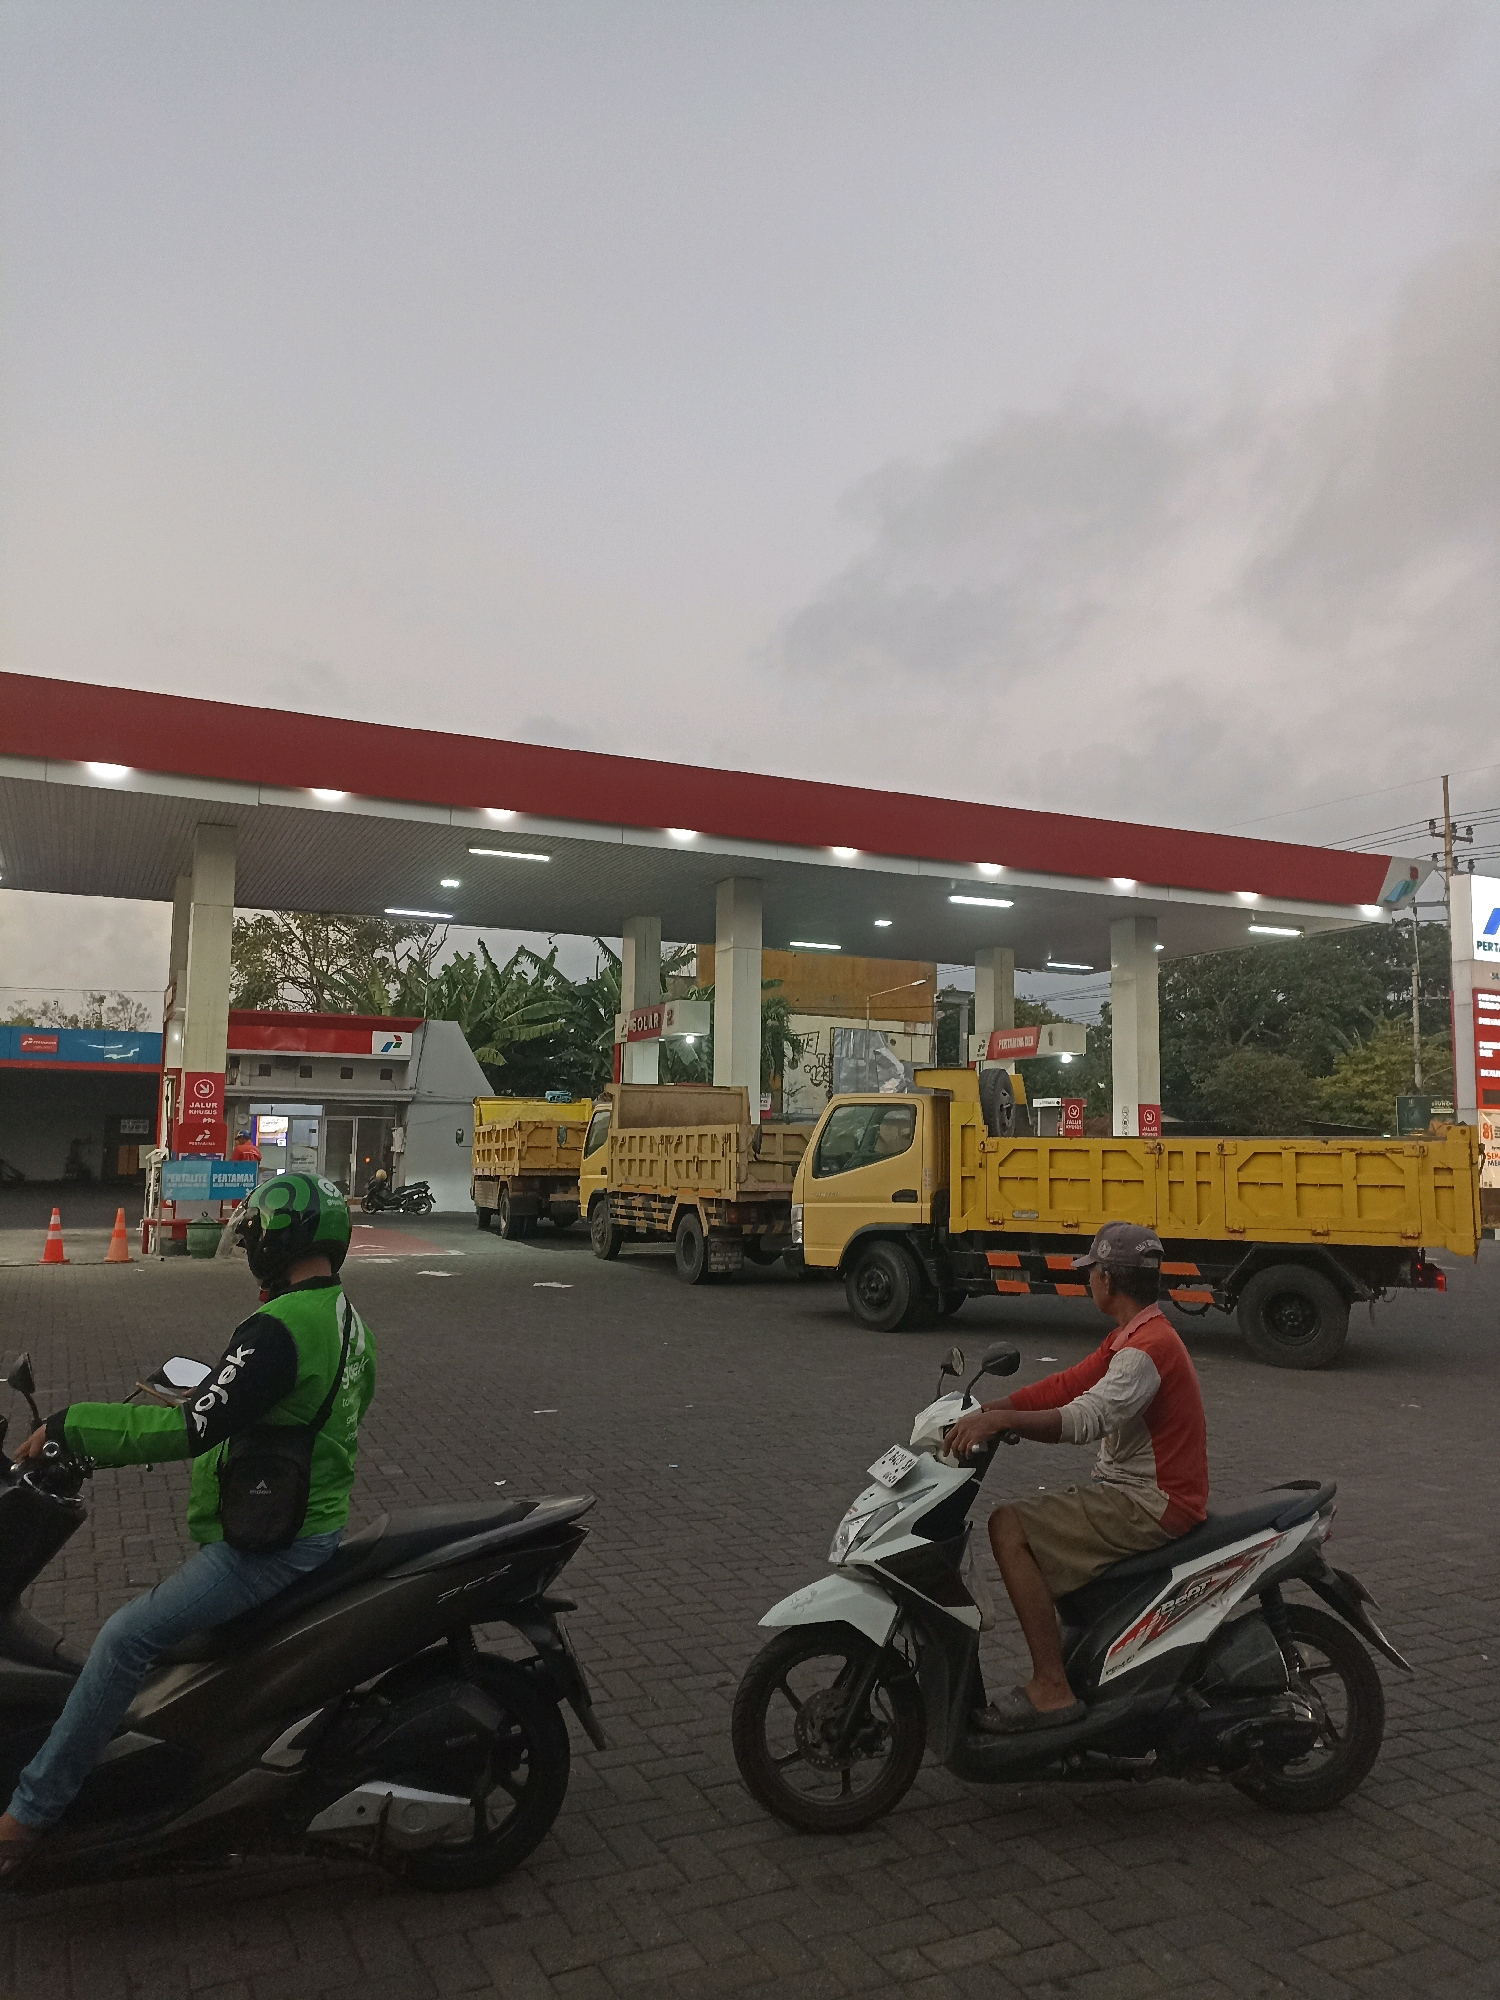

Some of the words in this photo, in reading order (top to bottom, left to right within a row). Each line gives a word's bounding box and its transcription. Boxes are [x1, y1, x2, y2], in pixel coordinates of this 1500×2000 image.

[632, 1012, 659, 1033] SOLAR
[1482, 1122, 1494, 1141] 81
[212, 1173, 255, 1183] PERTAMAX
[191, 1344, 256, 1438] gojek
